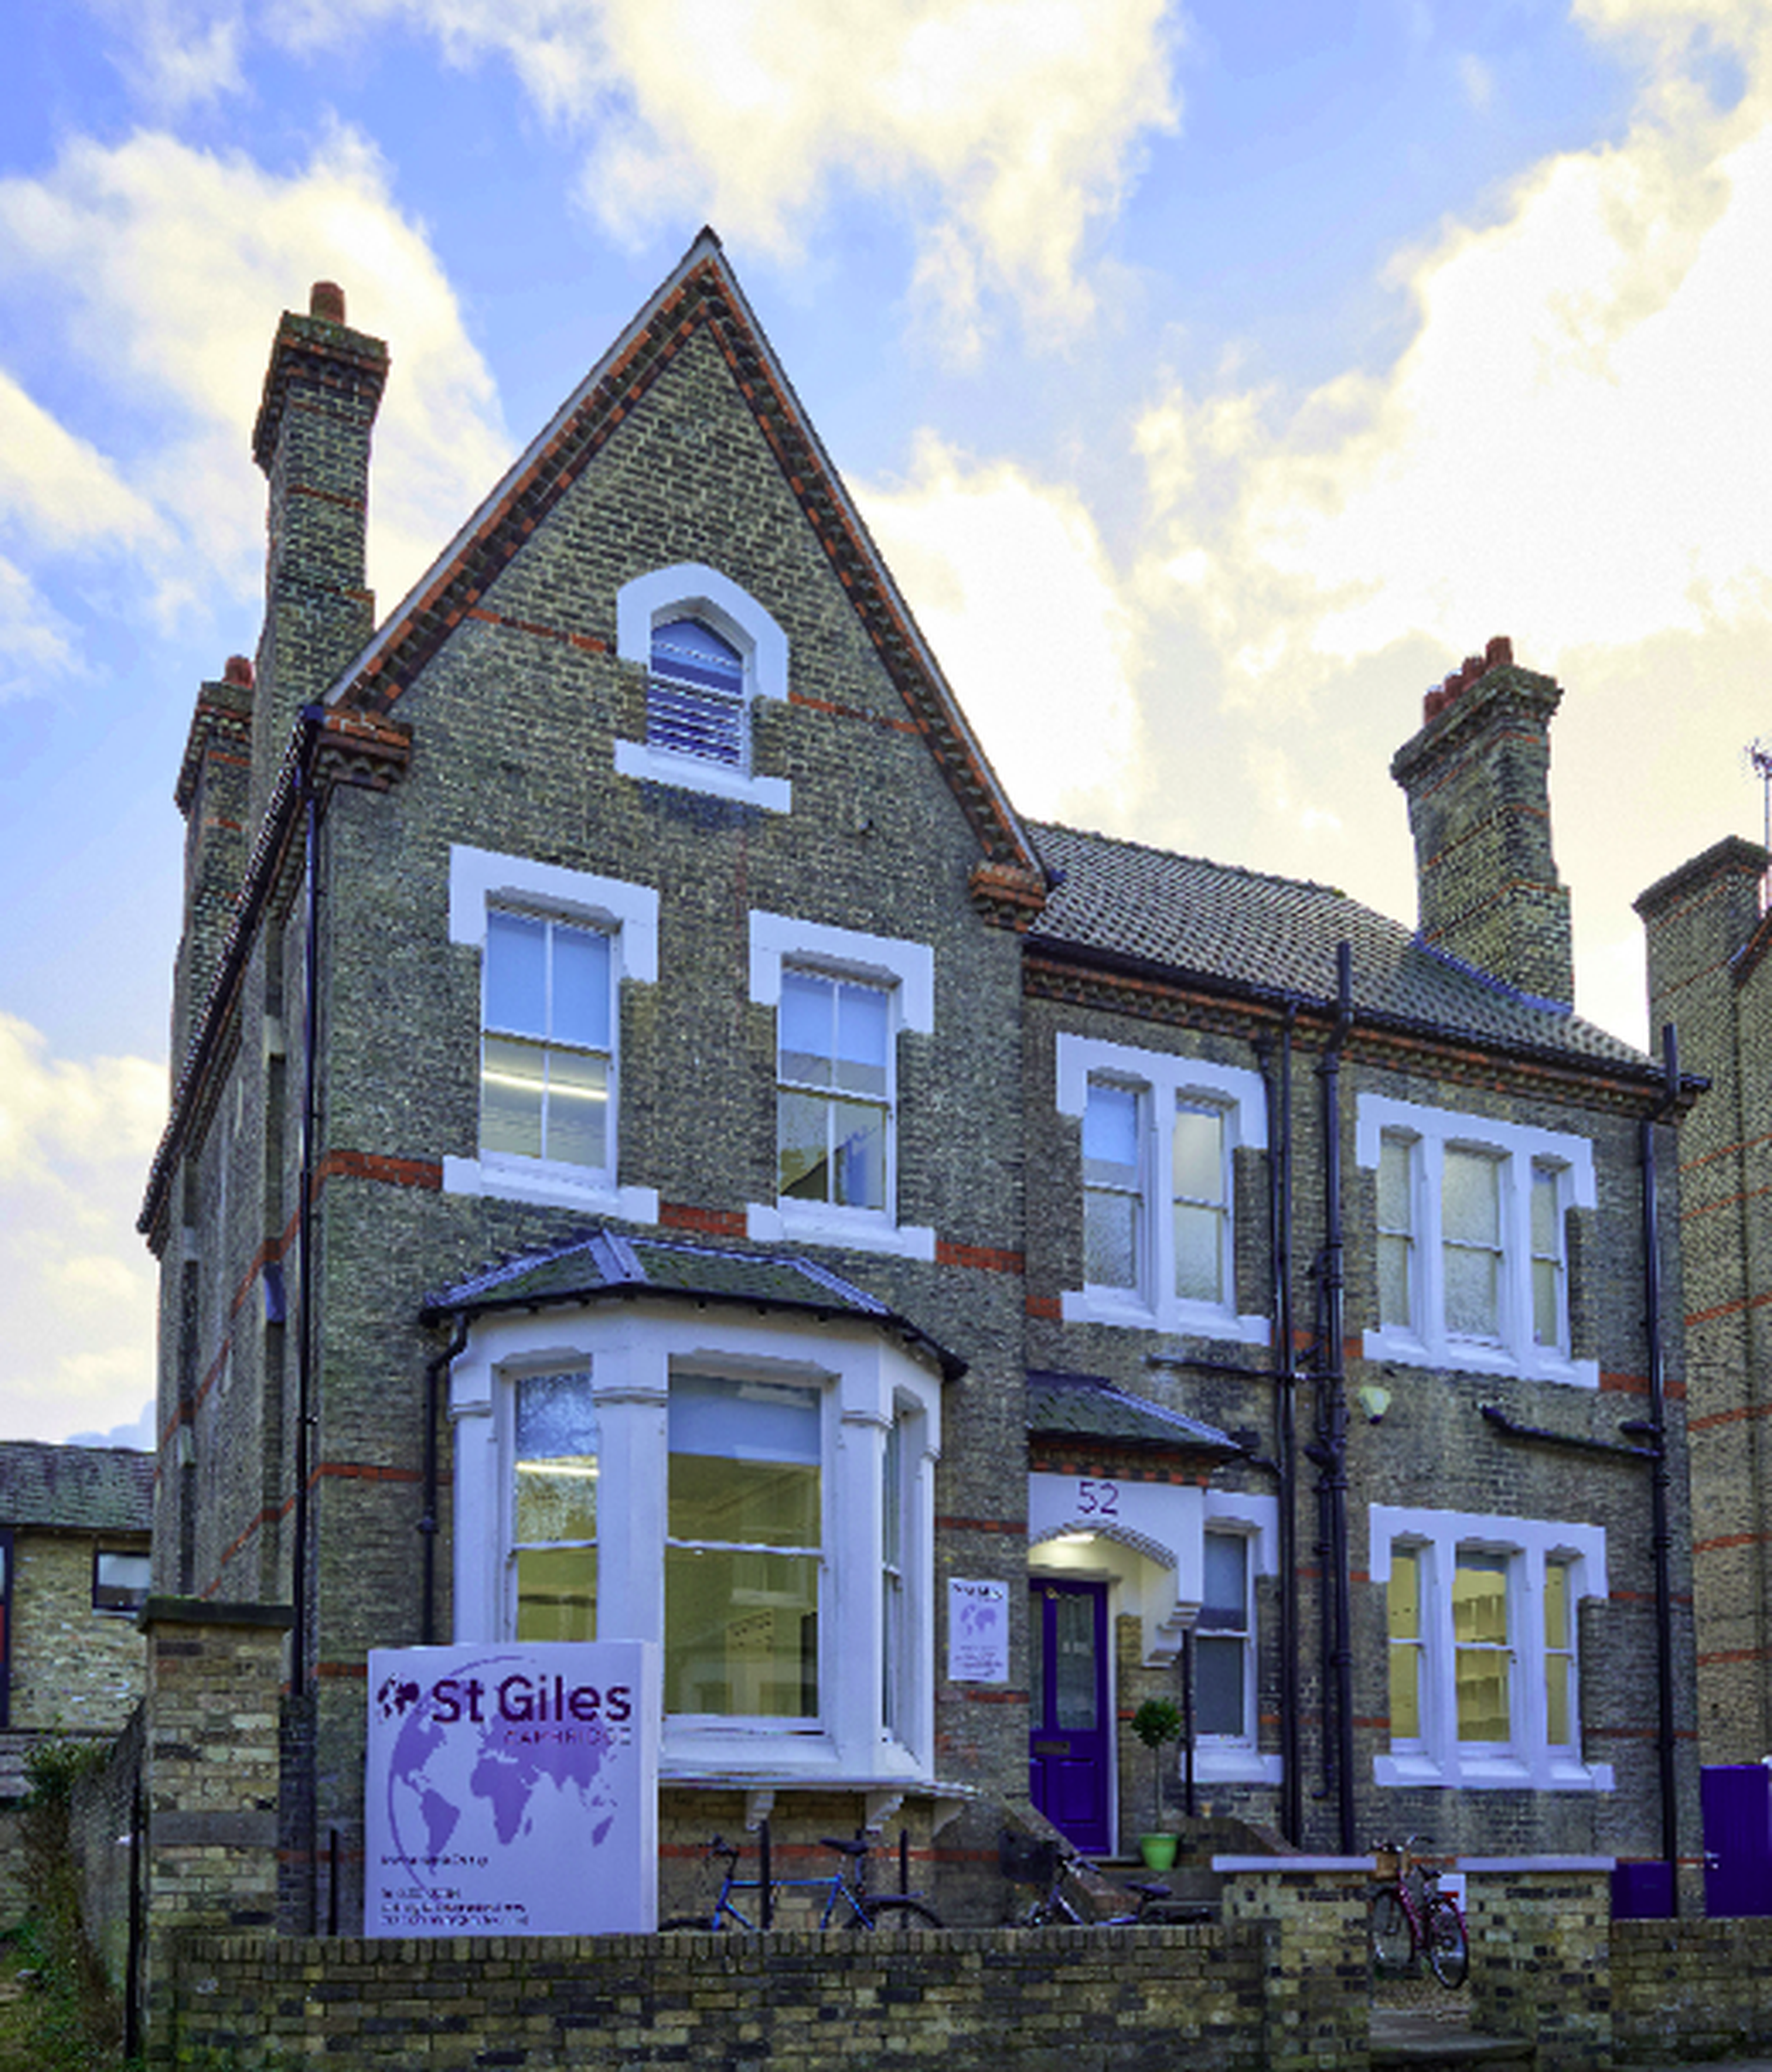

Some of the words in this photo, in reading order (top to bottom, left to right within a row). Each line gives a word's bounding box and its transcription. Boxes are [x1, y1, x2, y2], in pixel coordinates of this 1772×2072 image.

[1077, 1481, 1118, 1515] 52
[432, 1679, 484, 1723] St
[499, 1674, 631, 1722] Giles
